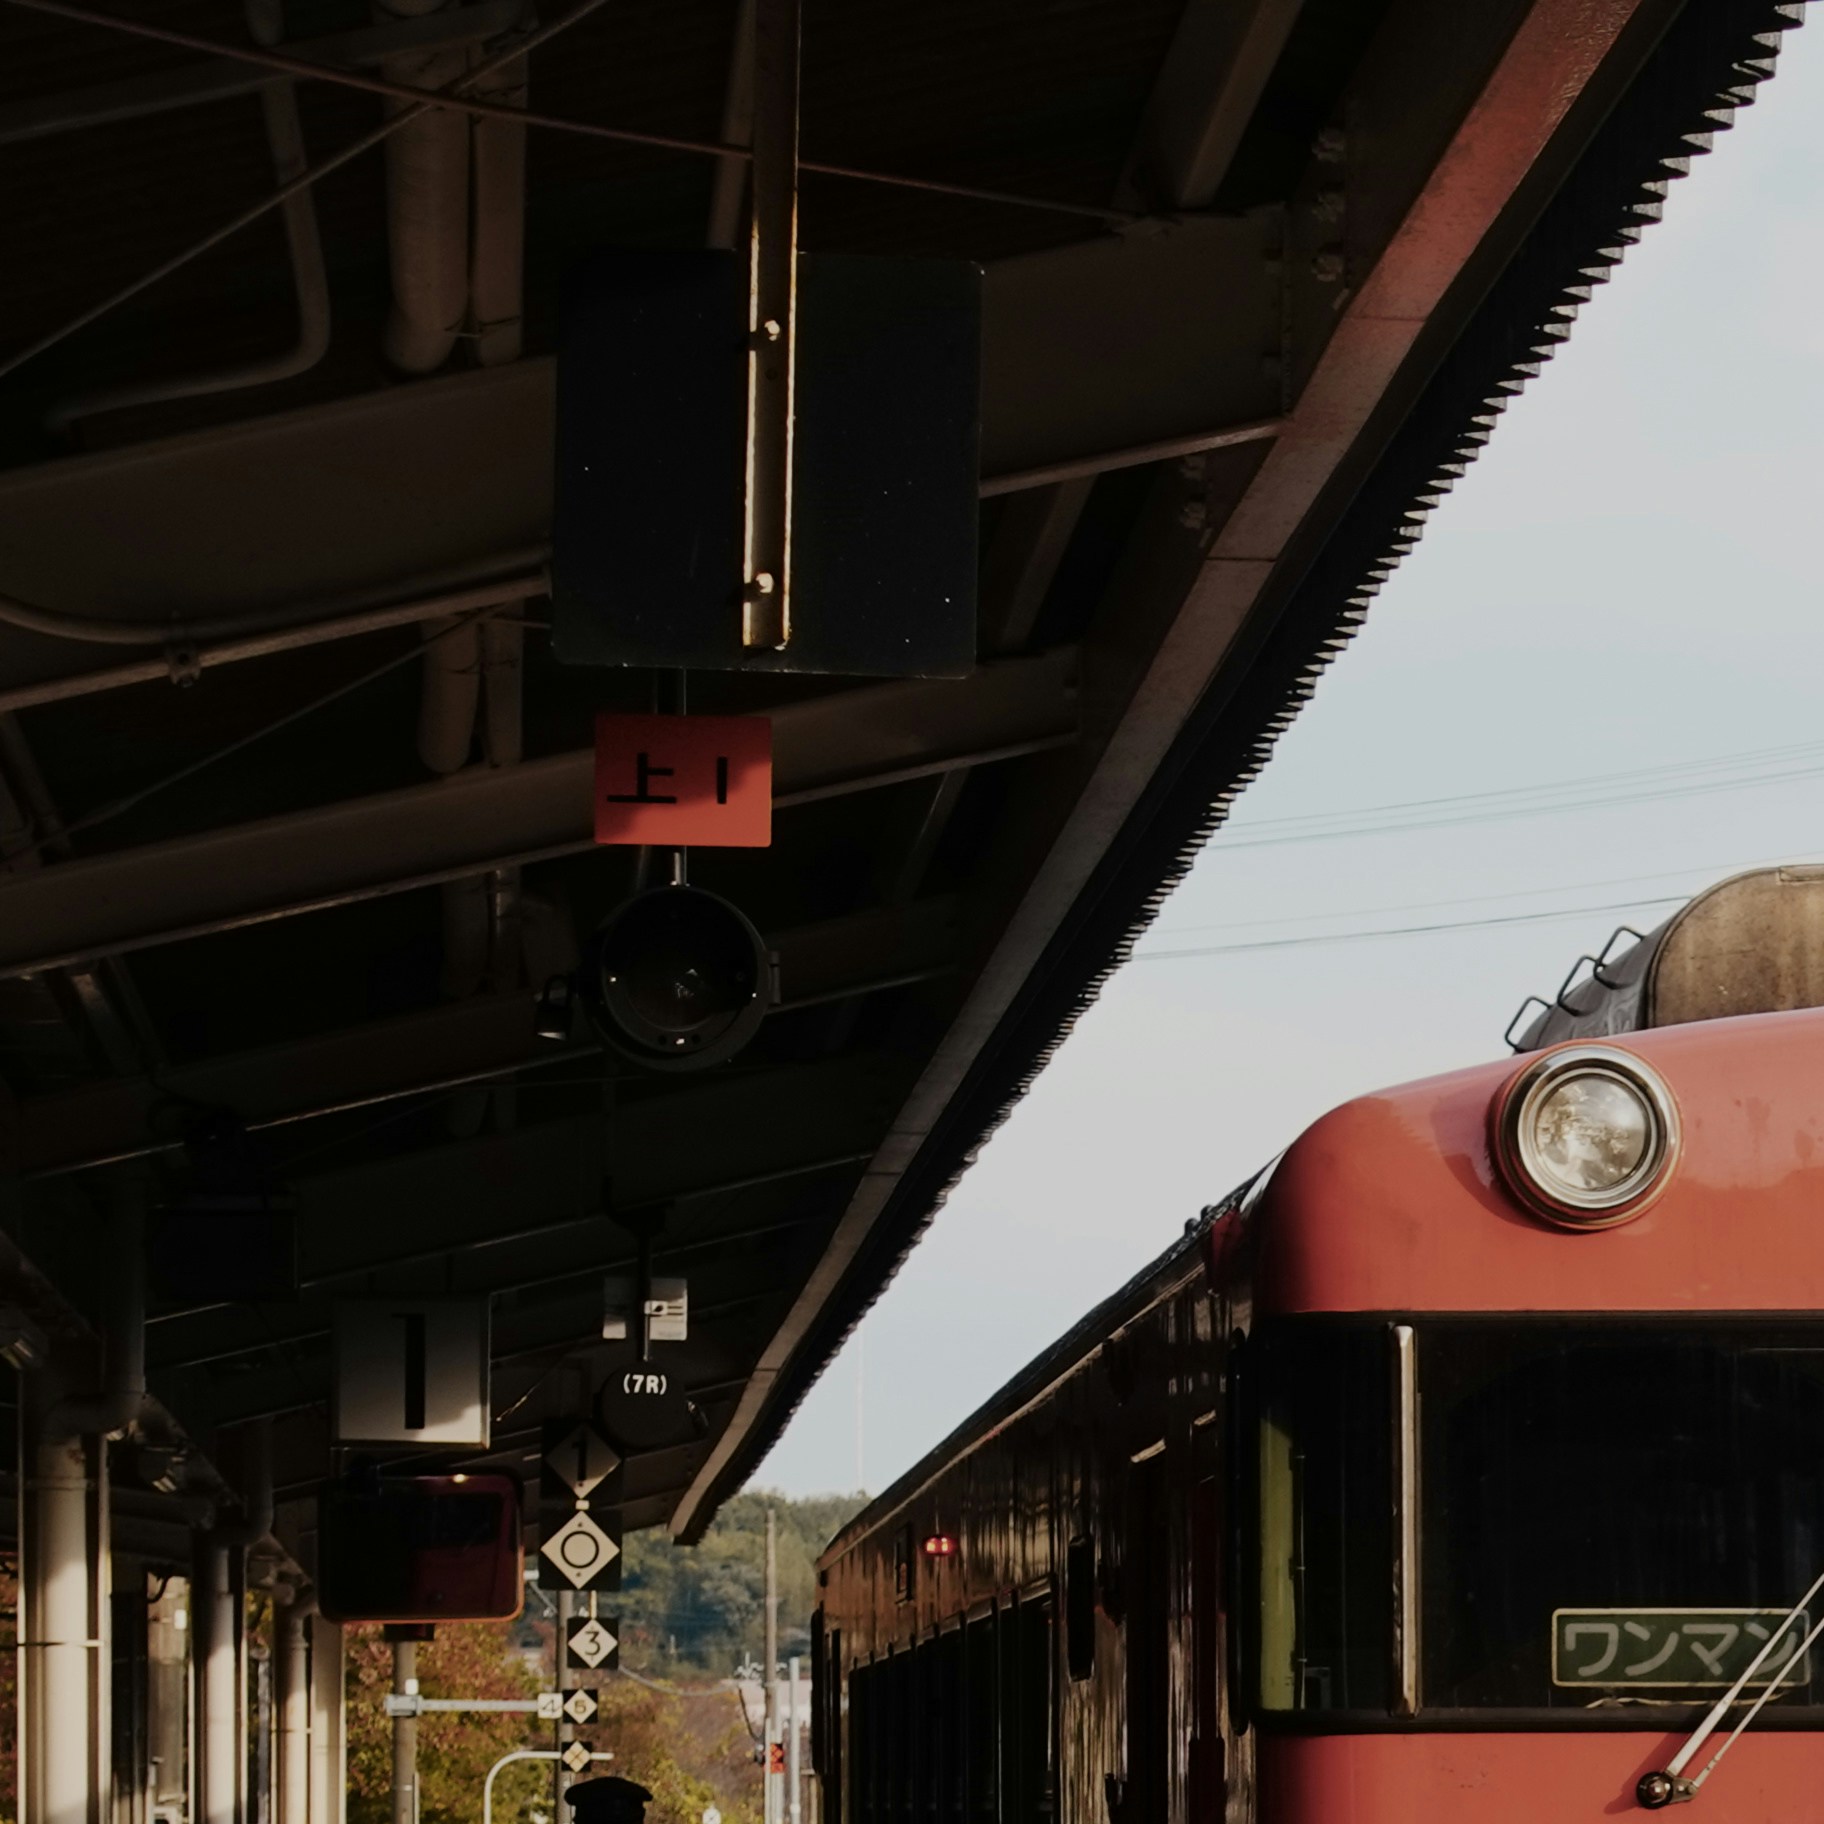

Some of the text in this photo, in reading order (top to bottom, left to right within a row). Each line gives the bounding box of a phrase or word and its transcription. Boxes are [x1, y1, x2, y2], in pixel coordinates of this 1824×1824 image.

[391, 1312, 425, 1429] 1
[623, 1373, 667, 1395] (7R)
[572, 1439, 588, 1481] 1
[585, 1630, 601, 1656] 3
[1565, 1621, 1797, 1676] ワンマン
